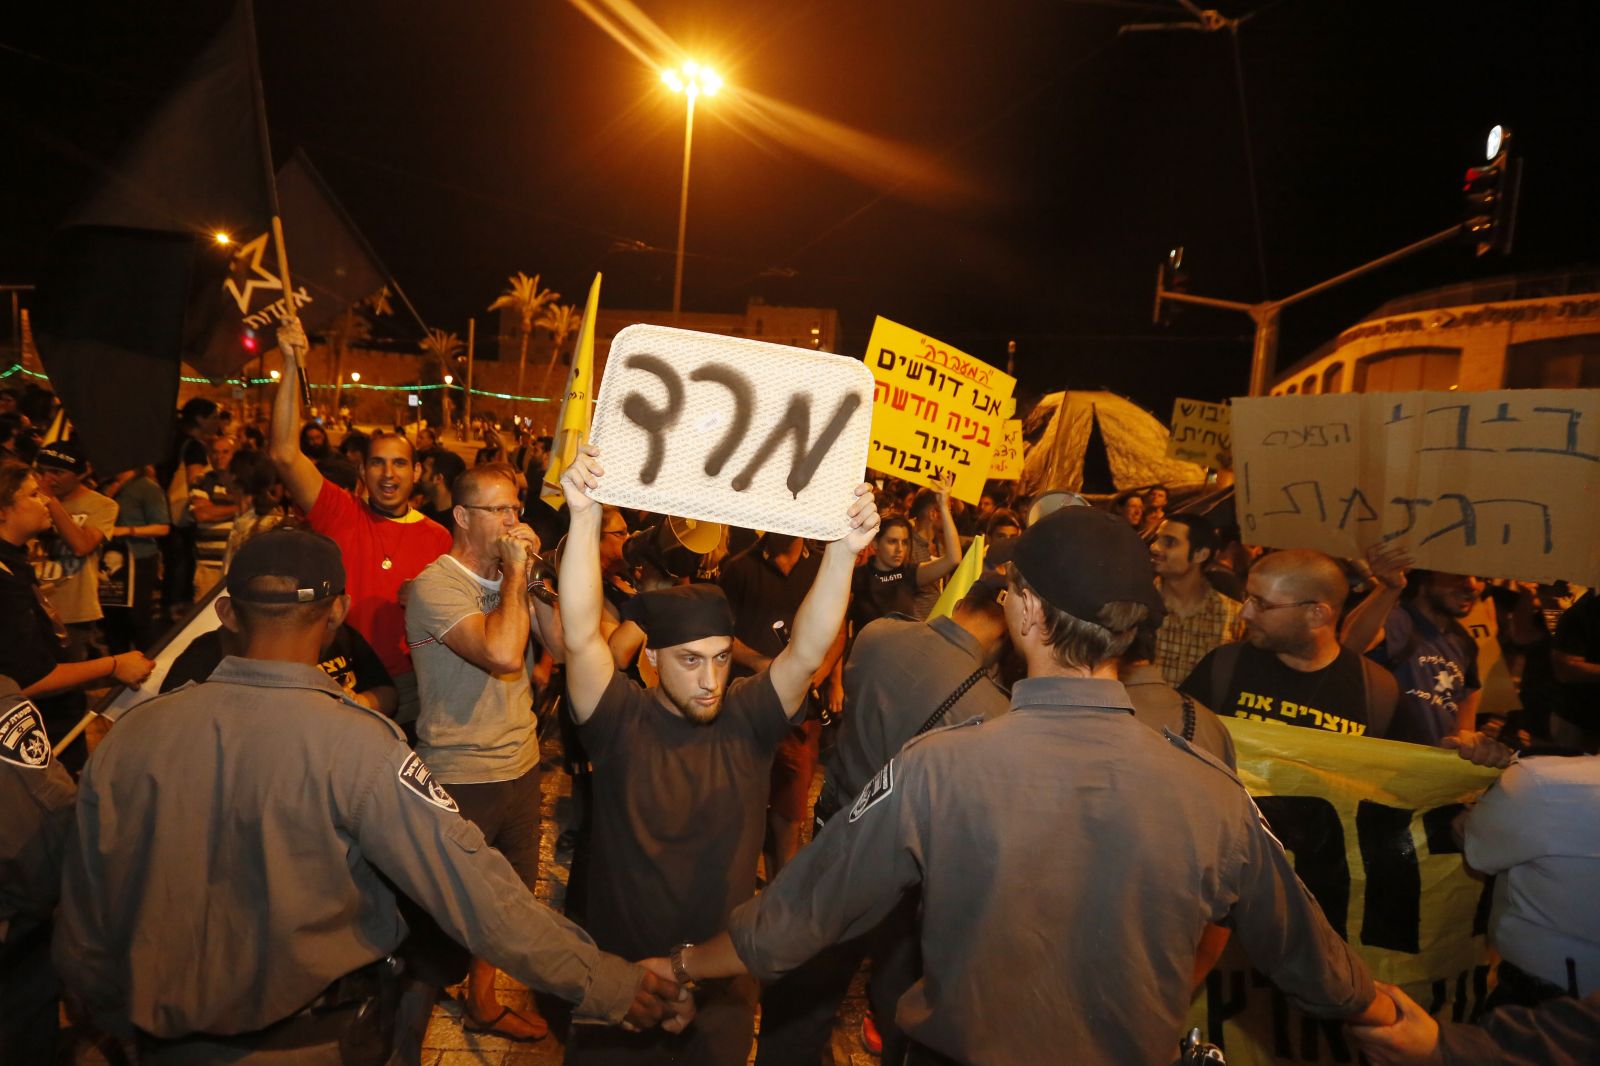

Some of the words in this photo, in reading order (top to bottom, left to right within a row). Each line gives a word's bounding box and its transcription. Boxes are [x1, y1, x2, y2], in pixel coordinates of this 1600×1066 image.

[877, 347, 964, 397] דורשים
[873, 380, 940, 423] חדשה
[972, 388, 1002, 417] אנו
[623, 353, 862, 500] מרץ
[946, 411, 991, 447] בניה
[1385, 402, 1600, 463] ביבי
[915, 429, 971, 466] בדיור
[1237, 691, 1273, 711] את
[1280, 700, 1366, 736] עוצרים
